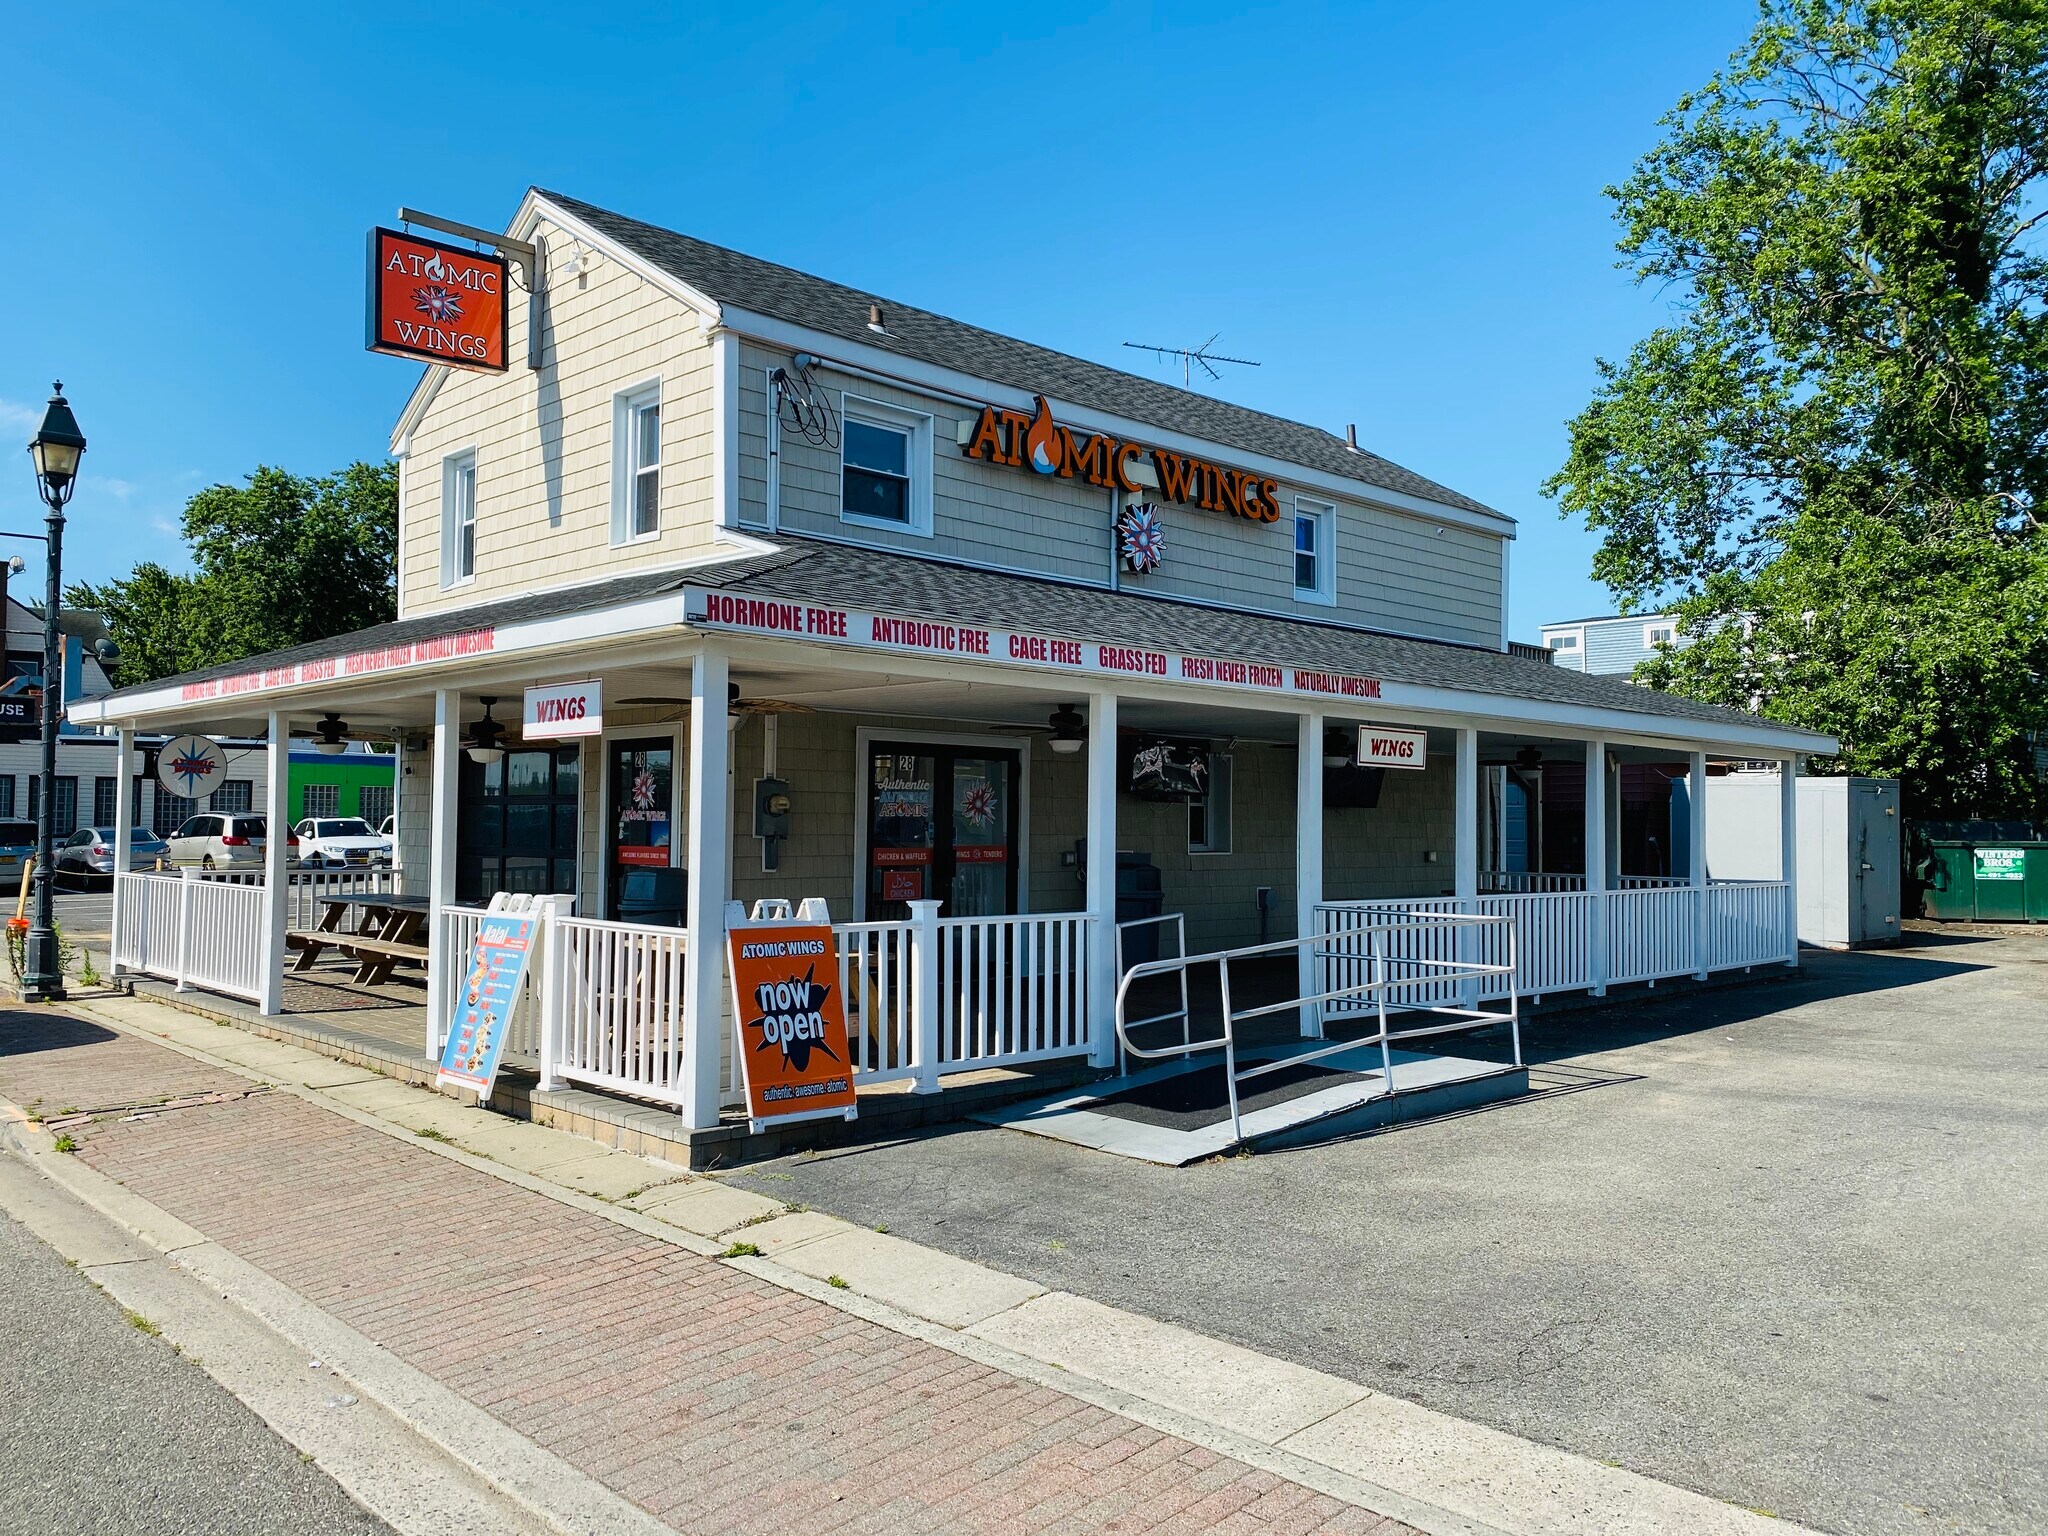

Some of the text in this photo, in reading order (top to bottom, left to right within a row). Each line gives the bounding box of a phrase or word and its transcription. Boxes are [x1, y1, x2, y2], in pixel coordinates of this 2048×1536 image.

[386, 249, 497, 294] ATOMIC
[394, 319, 487, 358] WINGS
[963, 394, 1281, 523] ATOMIC WINGS
[706, 594, 848, 637] HORMONE FREE
[415, 627, 495, 662] NATURALLY AWESOME
[872, 617, 990, 654] ANTIBIOTIC FREE
[344, 643, 412, 675] FRESH NEVER FROZEN
[1008, 634, 1082, 666] CAGE FREE
[1098, 645, 1167, 675] GRASS FED
[264, 664, 296, 687] CAGE FREE
[302, 657, 336, 682] GRASS FED
[1181, 657, 1283, 688] FRESH NEVER FROZEN
[1293, 670, 1381, 699] NATURALLY AWESOME
[536, 696, 587, 723] WINGS
[635, 751, 646, 767] 28
[1371, 738, 1415, 758] WINGS
[171, 758, 216, 768] ATOMIC
[900, 756, 913, 770] 28
[877, 777, 931, 791] Authentic
[879, 800, 929, 817] ATOMIC
[905, 852, 927, 860] WAFFLES
[1976, 850, 2023, 859] WINTERS
[1983, 858, 2016, 867] BROS.
[481, 924, 511, 945] Halal
[741, 940, 825, 959] ATOMIC WINGS
[760, 981, 812, 1012] now
[763, 1011, 824, 1055] open
[827, 1078, 848, 1093] atomic
